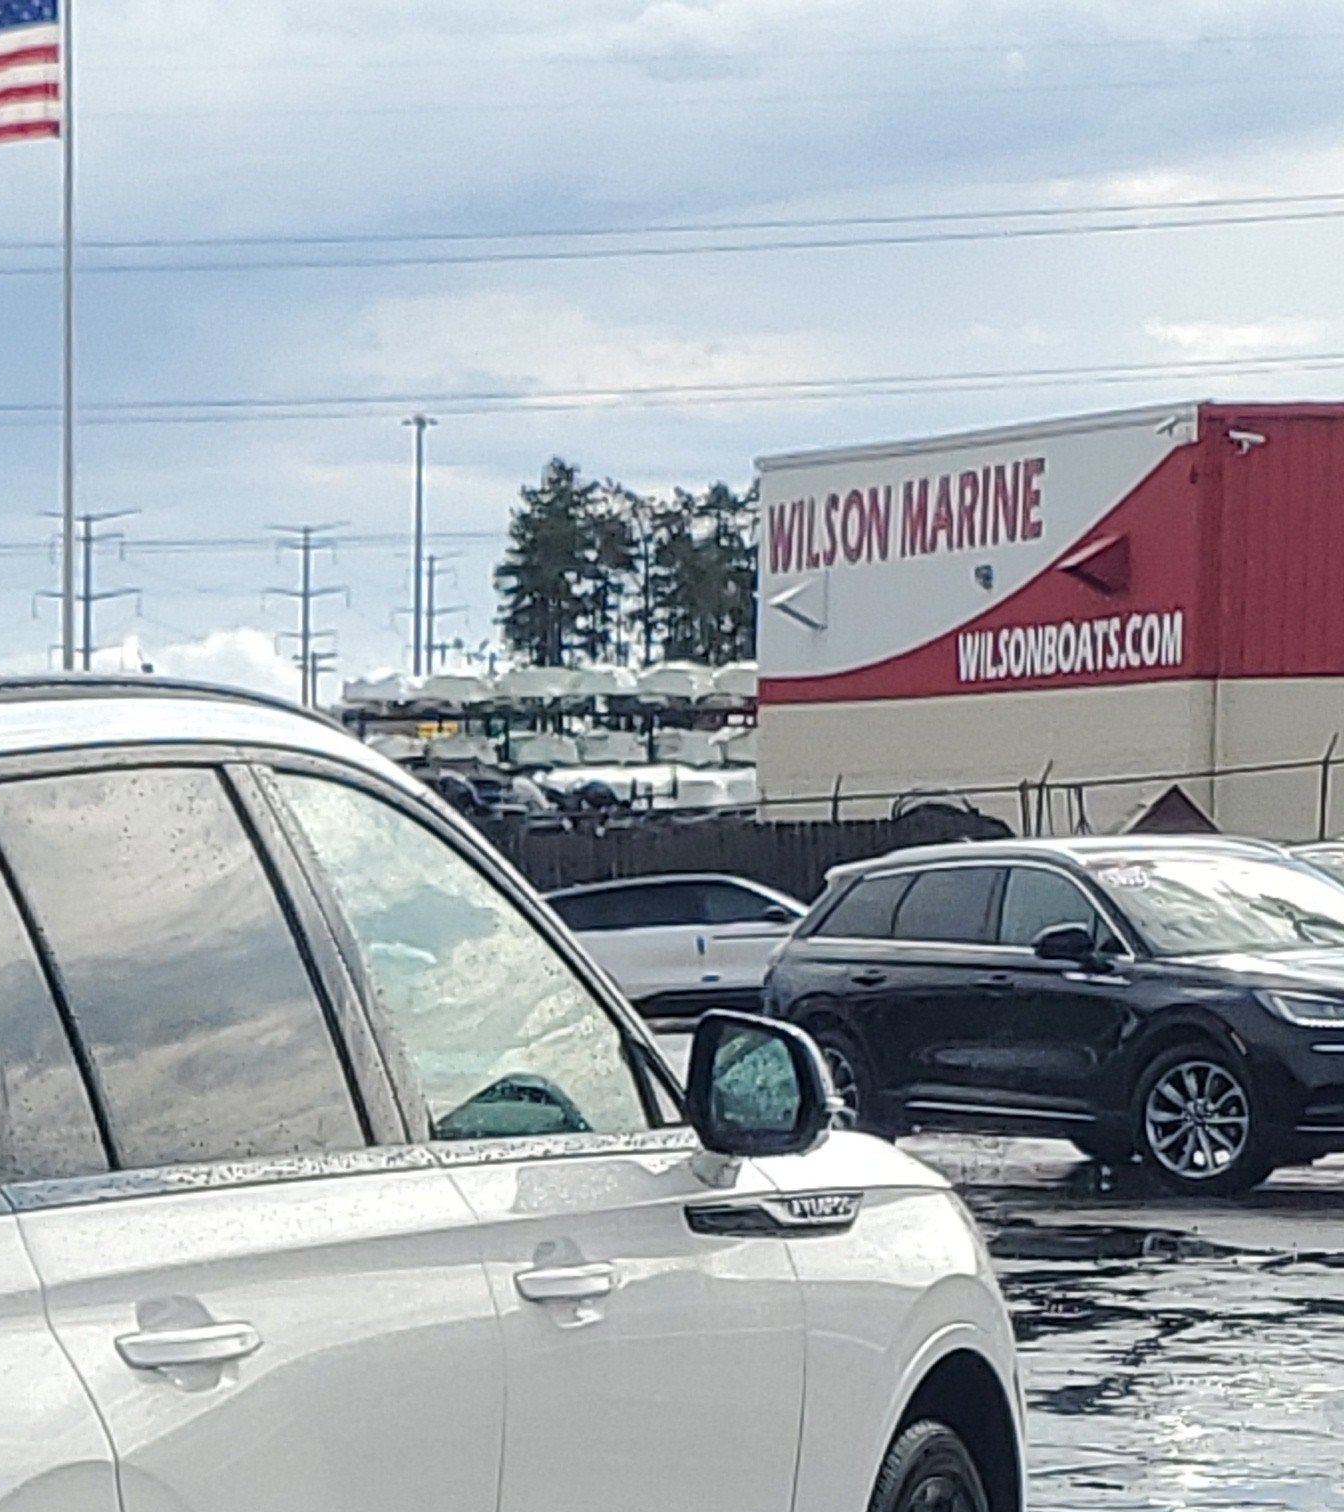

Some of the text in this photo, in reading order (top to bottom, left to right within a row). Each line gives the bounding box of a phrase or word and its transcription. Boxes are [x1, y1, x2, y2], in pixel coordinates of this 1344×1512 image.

[768, 456, 1047, 575] WILSON MARINE
[958, 610, 1185, 682] WILSONBOATS.COM
